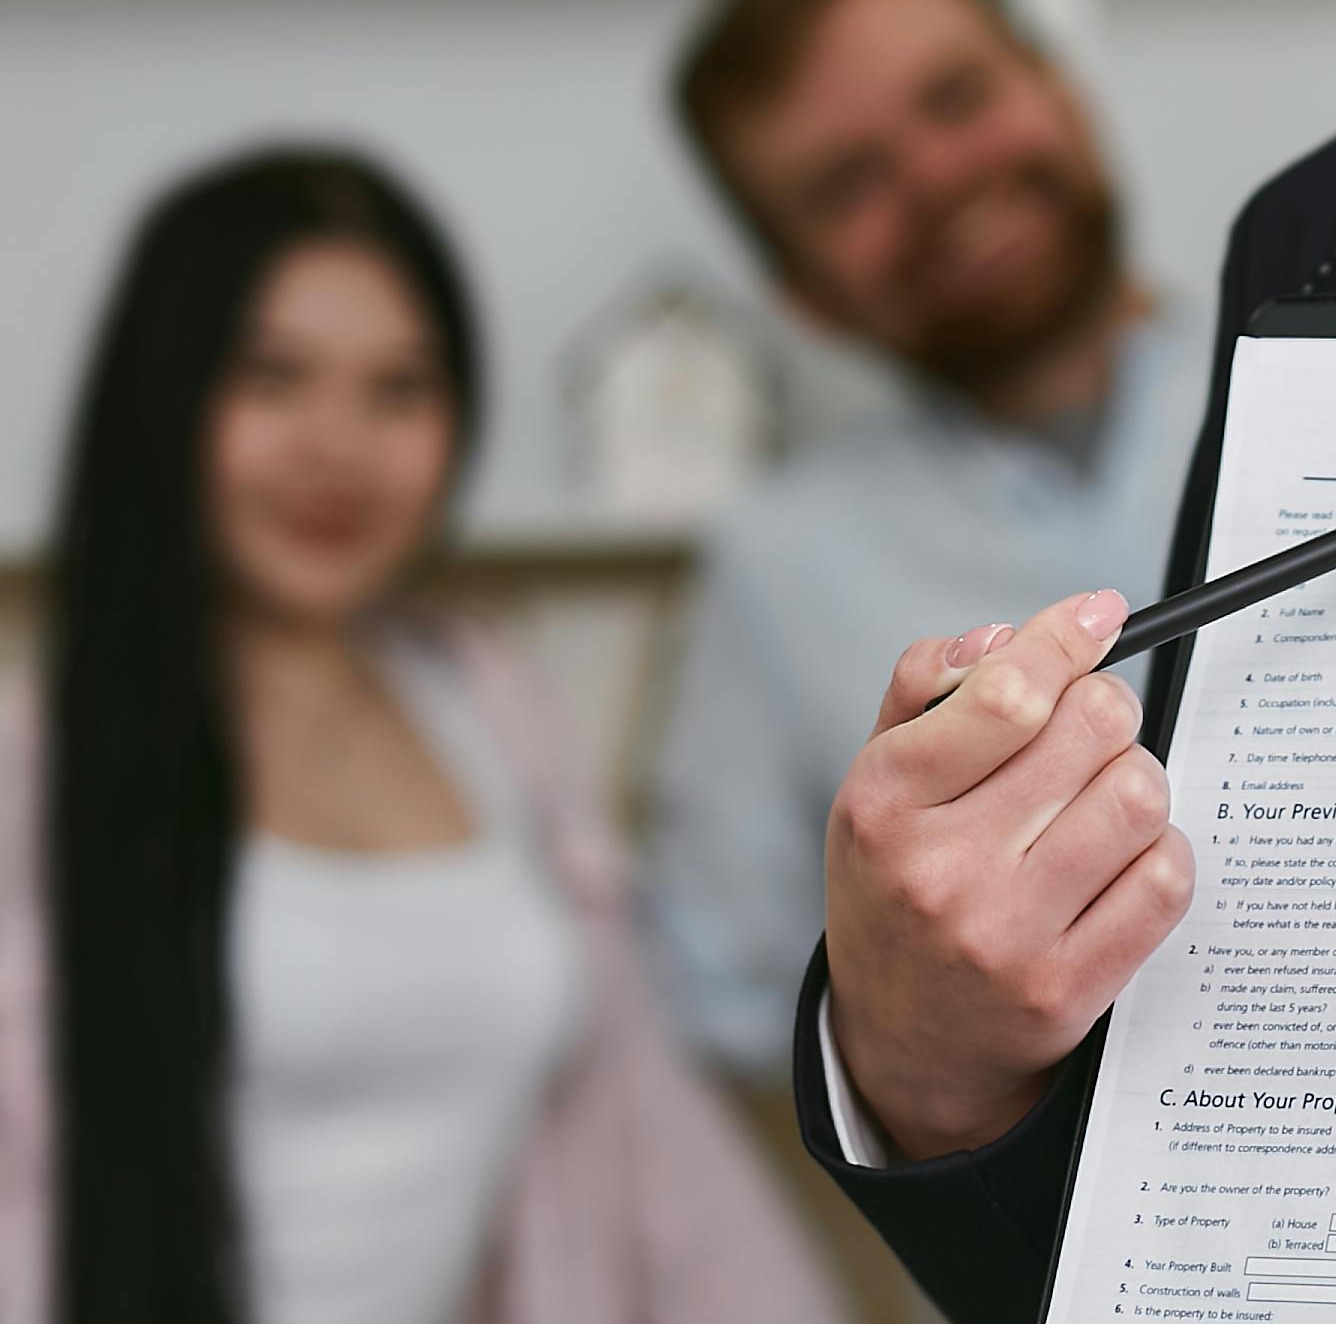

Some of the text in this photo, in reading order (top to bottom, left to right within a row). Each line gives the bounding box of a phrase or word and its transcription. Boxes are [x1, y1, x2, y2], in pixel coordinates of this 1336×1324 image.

[1216, 803, 1234, 820] B.
[1243, 803, 1287, 820] Your
[1228, 835, 1240, 845] a)
[1248, 835, 1274, 845] Have
[1275, 837, 1294, 847] you
[1295, 835, 1315, 846] had
[1316, 837, 1334, 847] any
[1224, 856, 1233, 867] If
[1250, 857, 1282, 869] please
[1283, 859, 1308, 868] state
[1309, 857, 1326, 868] the
[1221, 877, 1251, 888] expiry
[1252, 875, 1274, 886] date
[1275, 876, 1308, 886] and/or
[1207, 945, 1233, 956] Have
[1257, 948, 1269, 957] or
[1270, 948, 1289, 959] any
[1289, 946, 1331, 957] member
[1216, 1001, 1328, 1016] during the last 5 years?
[1159, 1088, 1177, 1107] C.
[1182, 1089, 1247, 1109] About
[1253, 1091, 1297, 1110] Your
[1171, 1121, 1211, 1133] Address
[1212, 1122, 1225, 1134] of
[1226, 1123, 1267, 1137] Property
[1268, 1125, 1280, 1135] to
[1281, 1124, 1295, 1135] be
[1296, 1125, 1333, 1136] insured
[1155, 1214, 1176, 1228] Type
[1177, 1215, 1190, 1227] of
[1190, 1215, 1231, 1230] Property
[1271, 1217, 1318, 1230] (a) House
[1267, 1238, 1325, 1252] (b) Terraced
[1145, 1259, 1167, 1271] Year
[1167, 1260, 1209, 1275] Property
[1209, 1261, 1232, 1273] Built
[1139, 1283, 1201, 1298] Construction
[1202, 1286, 1215, 1298] of
[1217, 1288, 1241, 1299] walls
[1134, 1305, 1143, 1316] Is
[1145, 1305, 1162, 1317] the
[1162, 1308, 1206, 1321] property
[1207, 1310, 1219, 1320] to
[1219, 1308, 1234, 1321] be
